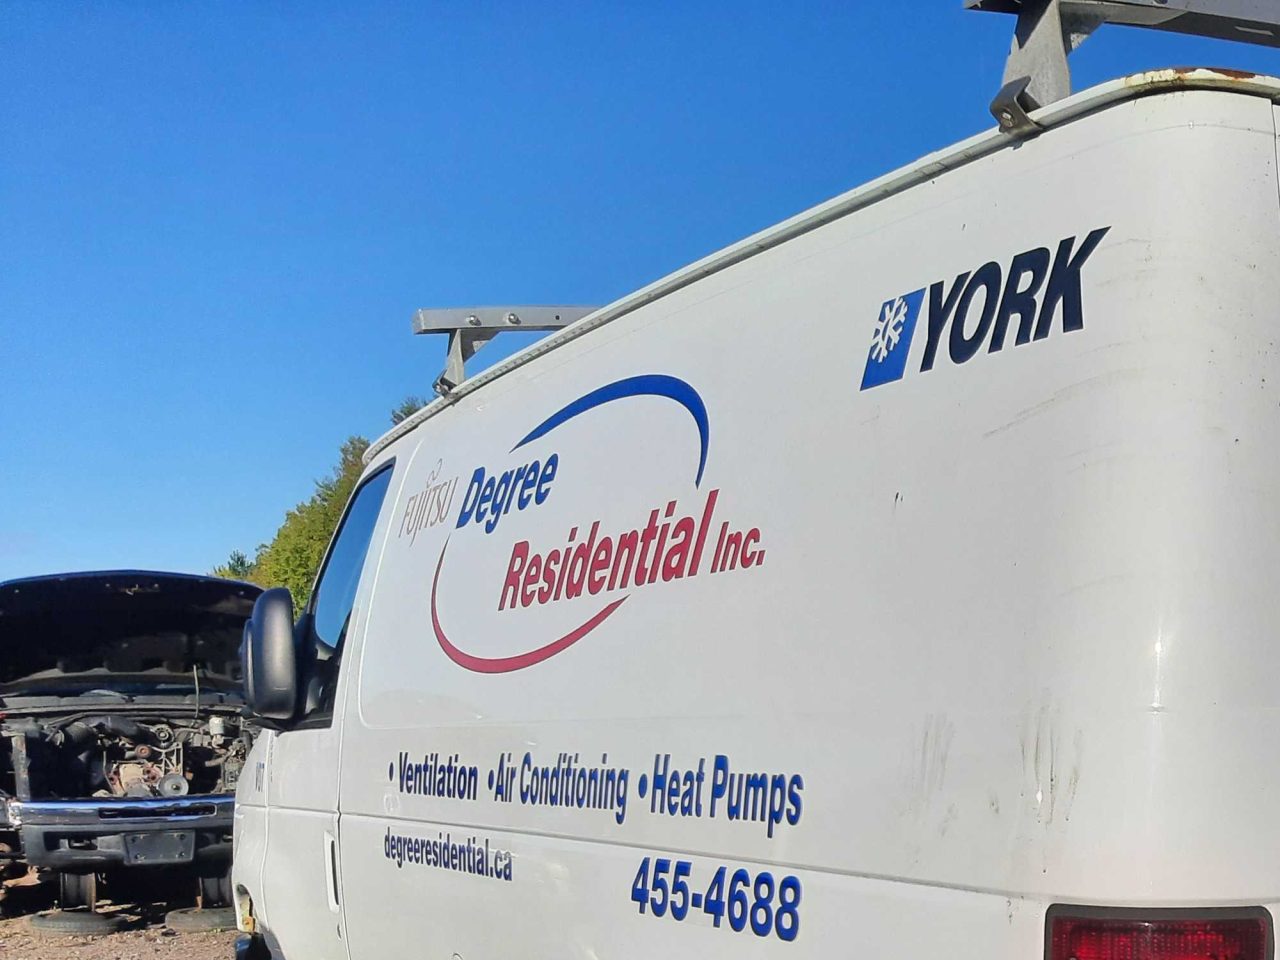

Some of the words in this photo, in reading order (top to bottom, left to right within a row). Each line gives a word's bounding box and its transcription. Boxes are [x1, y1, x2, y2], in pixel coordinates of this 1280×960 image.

[920, 226, 1111, 372] YORK
[399, 476, 458, 547] FUJITSU
[456, 453, 559, 533] Degree
[498, 489, 719, 611] Residential
[710, 521, 766, 574] Inc.
[399, 752, 478, 801] Ventilation
[495, 753, 518, 803] Air
[519, 752, 630, 824] Conditioning
[650, 753, 705, 818] Heat
[709, 754, 804, 838] Pumps
[383, 827, 513, 881] degreeresidential.ca
[631, 857, 802, 942] 455-4688
